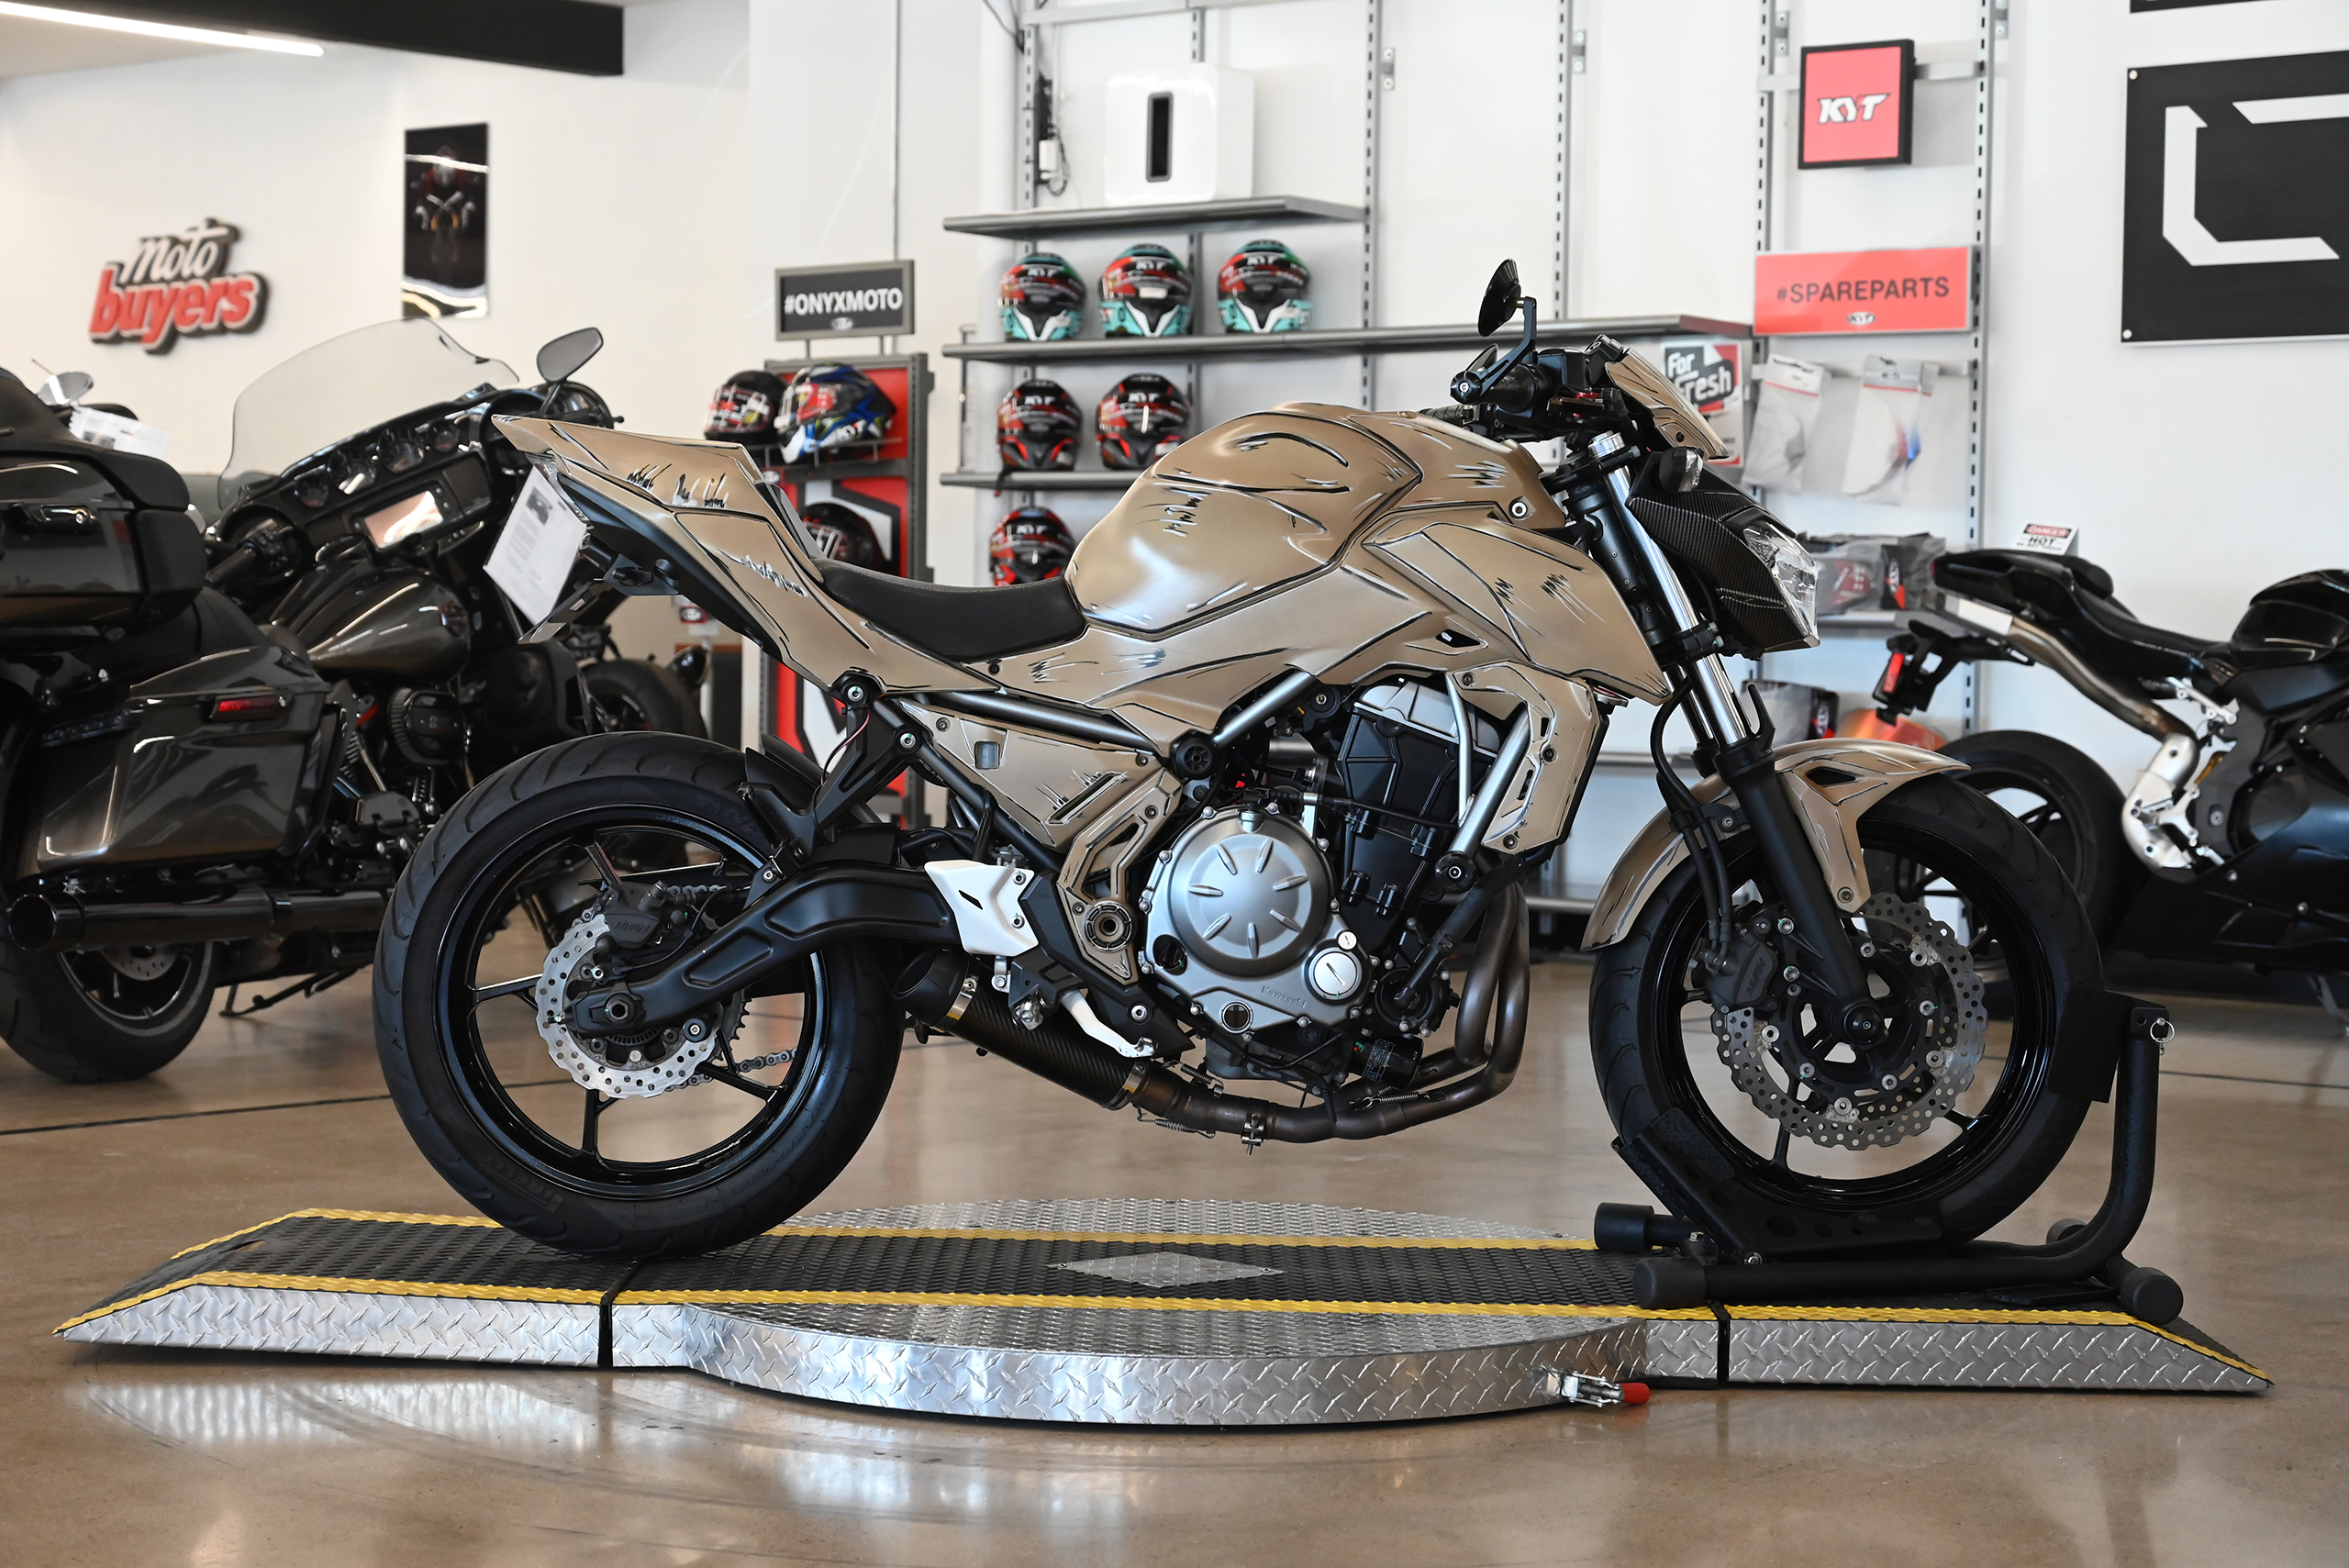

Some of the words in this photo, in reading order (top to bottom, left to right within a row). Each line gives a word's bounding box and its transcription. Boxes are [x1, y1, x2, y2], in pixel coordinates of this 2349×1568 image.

[1818, 93, 1891, 124] KYT
[784, 287, 904, 316] #ONYXMOTO
[1776, 276, 1950, 304] #SPAREPARTS
[90, 266, 256, 346] buyers
[1667, 351, 1696, 378] For
[1261, 985, 1307, 1009] Kawasaki
